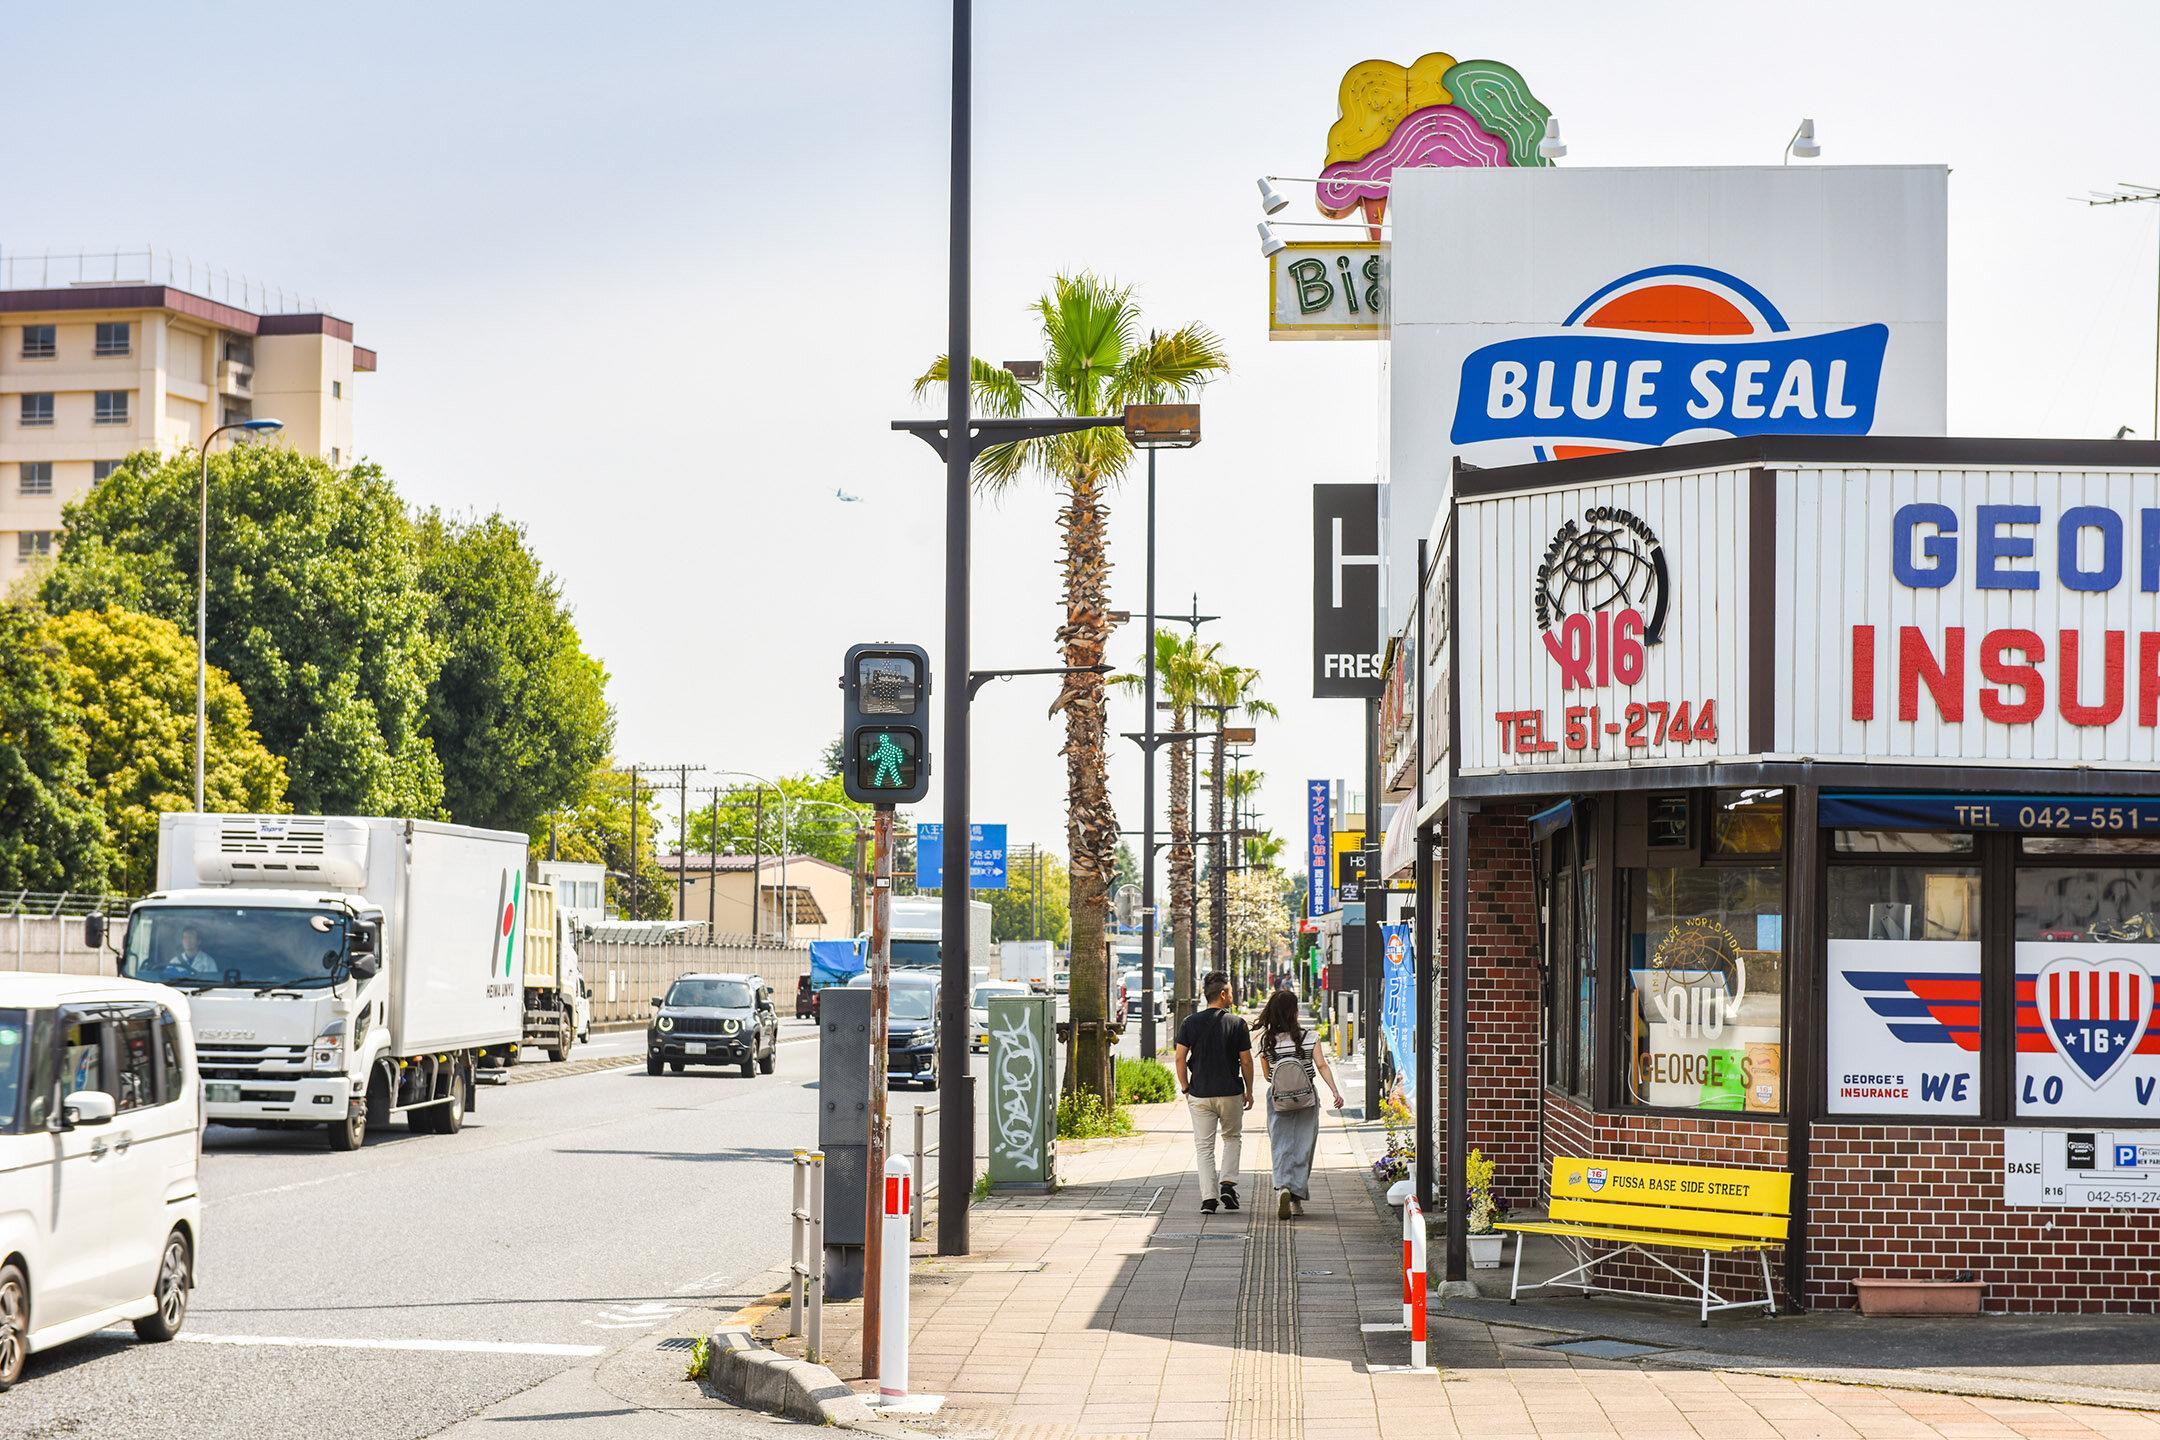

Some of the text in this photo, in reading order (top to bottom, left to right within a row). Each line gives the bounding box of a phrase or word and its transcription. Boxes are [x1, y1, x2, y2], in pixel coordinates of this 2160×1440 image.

[1486, 359, 1857, 420] BLUE SEAL
[1585, 506, 1660, 547] COMPANY
[1535, 518, 1579, 629] INSURANCE
[1495, 699, 1718, 754] TEL 51-2744
[920, 825, 944, 835] 八王
[1954, 806, 2160, 830] TEL 042-551-
[1312, 796, 1326, 867] アイビー化粧品
[199, 1028, 256, 1040] ISUZU
[2080, 1028, 2110, 1053] 16
[1640, 1053, 1753, 1089] GEORGE'S
[1843, 1074, 1904, 1085] GEORGE'S
[1840, 1087, 1909, 1098] INSURANCE
[1921, 1072, 1971, 1102] WE
[2120, 1148, 2133, 1164] P
[2008, 1163, 2041, 1174] BASE
[1612, 1176, 1750, 1197] FUSSA BASE SIDE STREET
[2044, 1187, 2063, 1196] R 16
